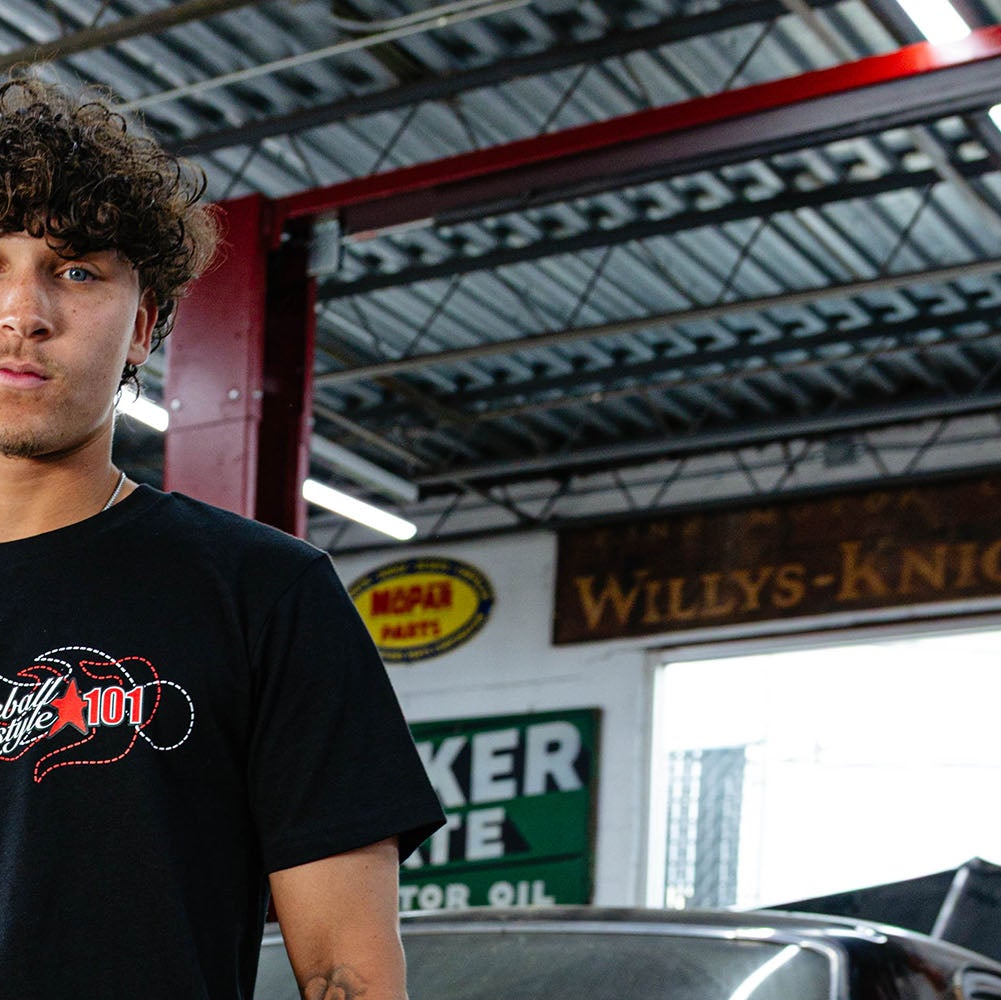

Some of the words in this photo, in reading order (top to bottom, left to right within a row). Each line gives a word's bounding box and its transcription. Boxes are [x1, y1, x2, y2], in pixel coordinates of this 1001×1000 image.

[371, 579, 453, 617] MOPAR
[381, 620, 440, 641] PARTS
[83, 685, 143, 727] 101
[487, 879, 556, 909] OIL
